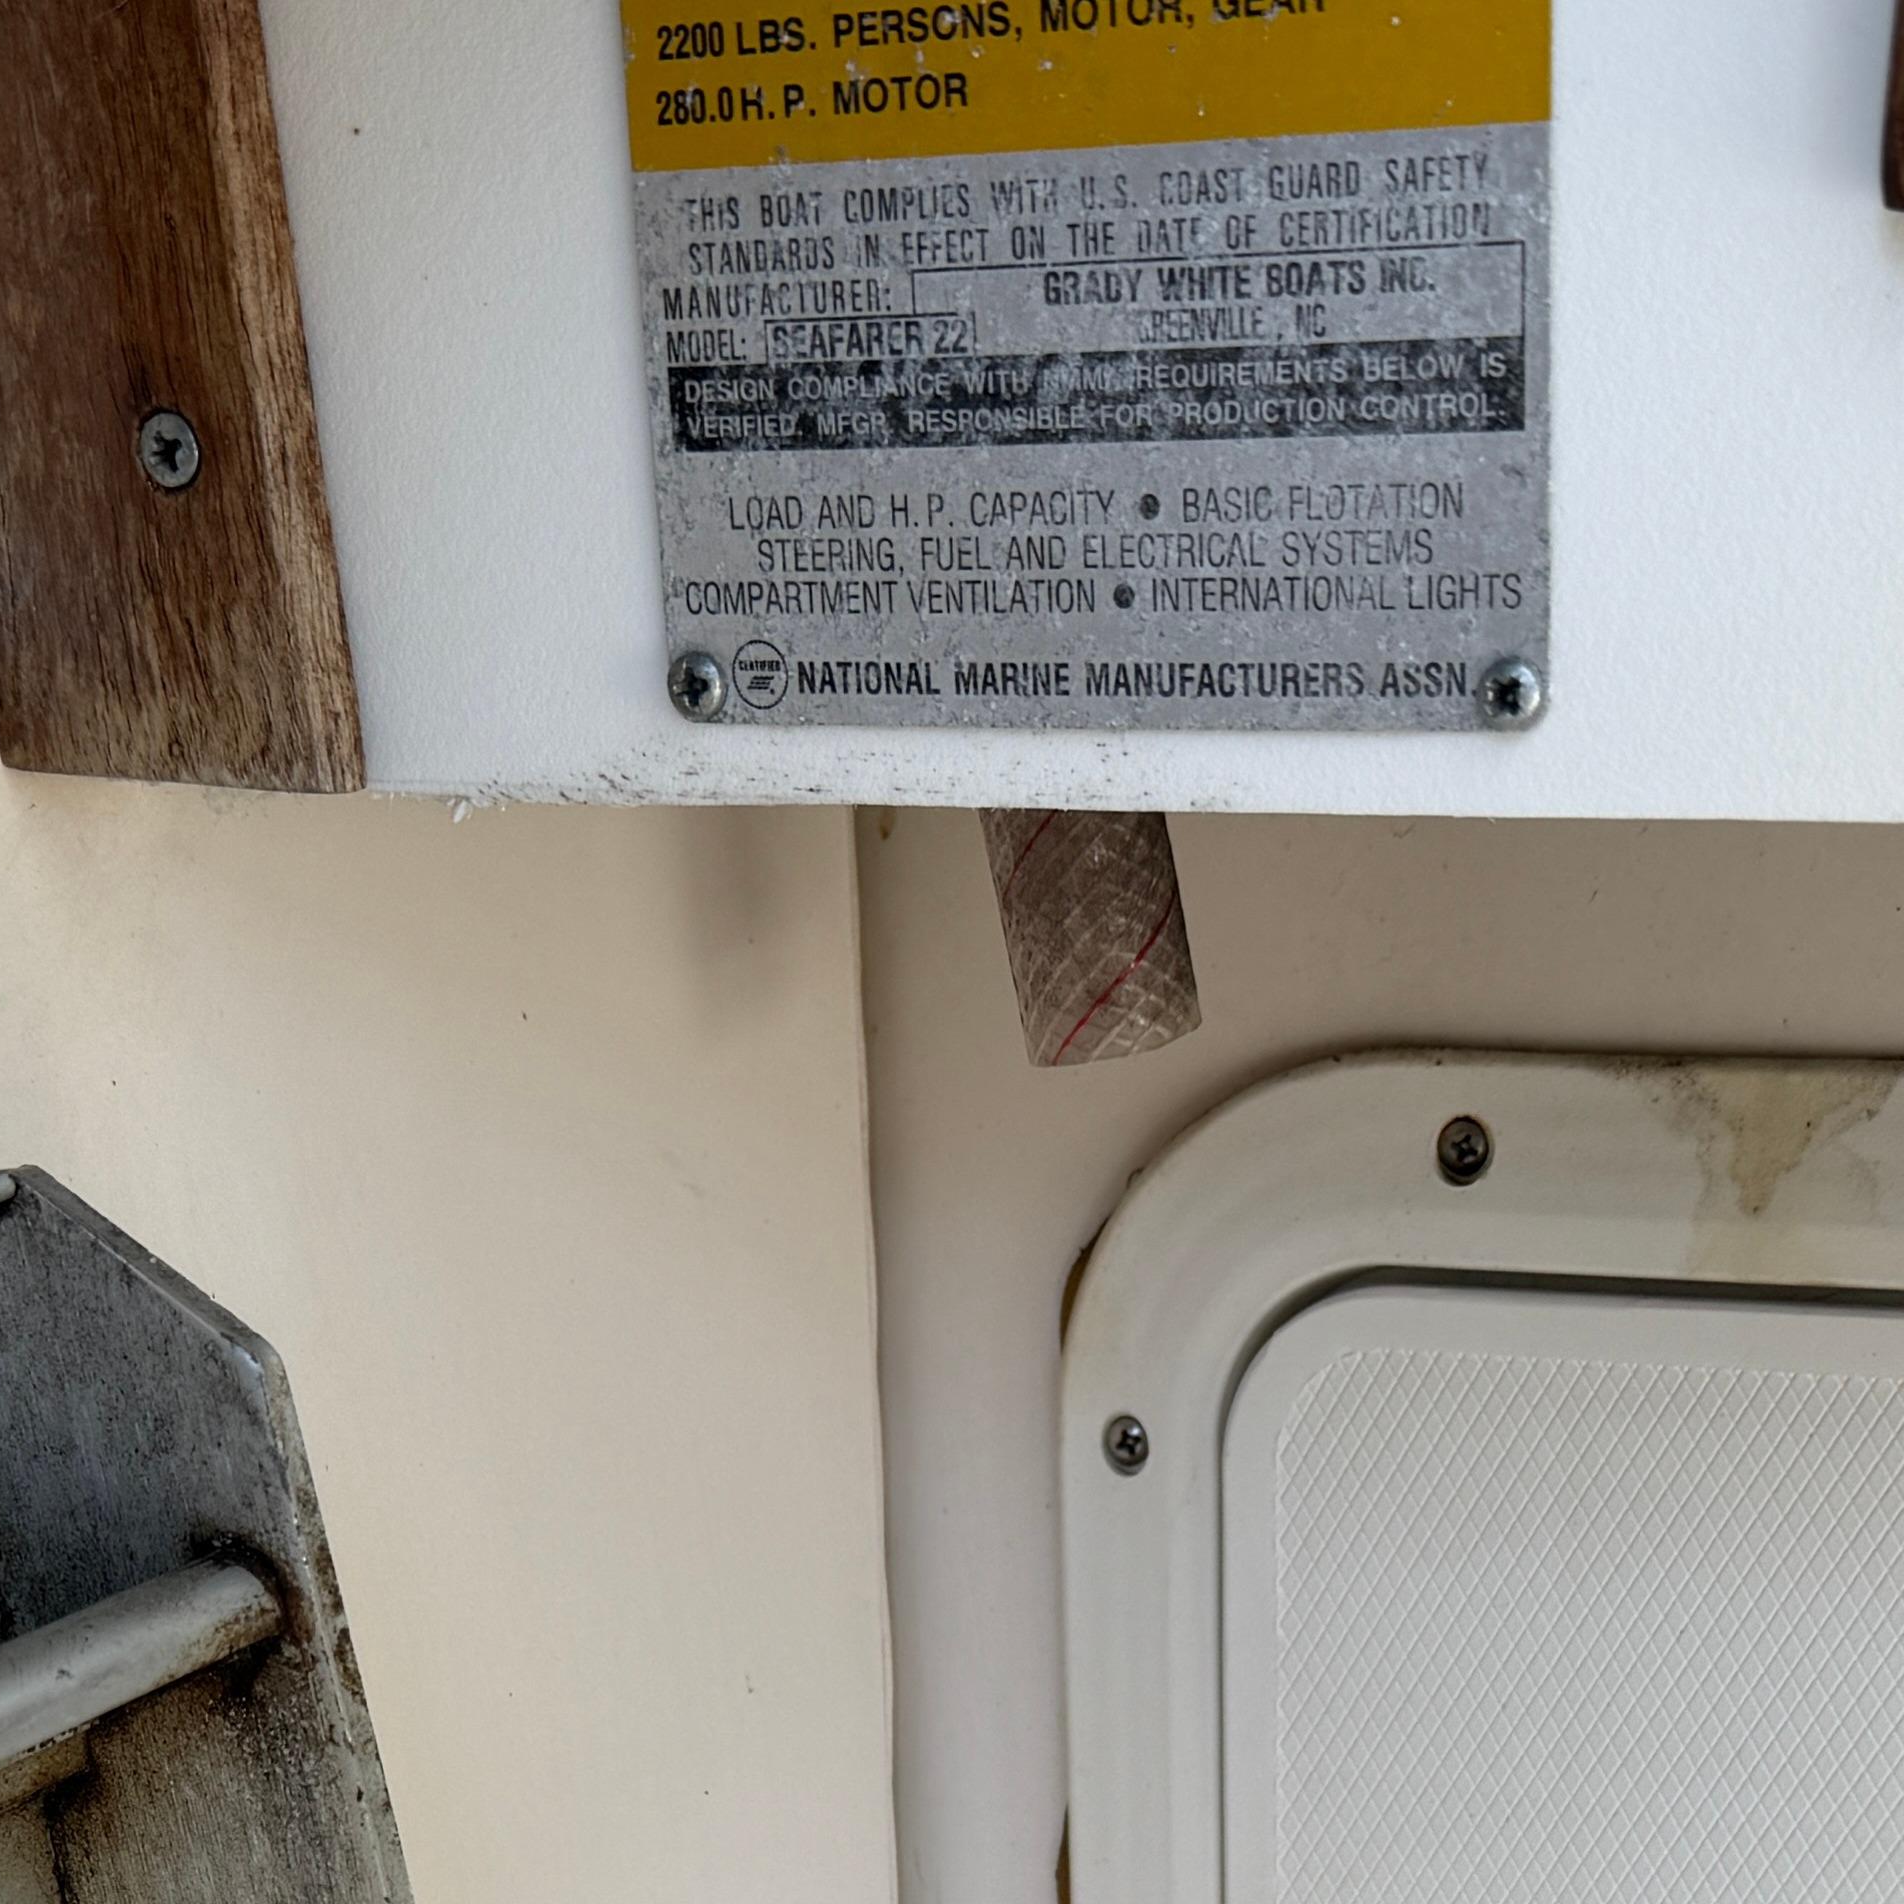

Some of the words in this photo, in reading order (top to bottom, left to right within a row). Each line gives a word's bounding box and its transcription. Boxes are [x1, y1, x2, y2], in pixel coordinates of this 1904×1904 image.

[657, 21, 724, 61] 2200
[736, 17, 816, 56] LBS.
[833, 1, 1022, 48] PERSONS,
[1041, 0, 1194, 32] MOTOR,
[832, 72, 968, 115] MOTOR
[684, 196, 740, 232] THIS
[759, 191, 823, 228] BOAT
[844, 183, 971, 224] COMPLIES
[990, 177, 1058, 215] WITH
[1159, 167, 1245, 208] COAST
[1268, 160, 1361, 201] GUARD
[1385, 153, 1489, 194] SAFETY
[688, 236, 835, 276] STANDARDS
[856, 233, 881, 268] IN
[902, 228, 989, 266] EFFECT
[1011, 224, 1046, 260] ON
[1066, 221, 1116, 257] THE
[1137, 216, 1202, 252] DATE
[1225, 214, 1257, 250] OF
[1279, 202, 1490, 248] CERTIFICATION
[662, 278, 892, 321] MANUFACTURER:
[1045, 267, 1143, 306] GRADY
[1157, 264, 1252, 301] WHITE
[1266, 259, 1366, 298] BOATS
[1379, 255, 1436, 294] INC.
[666, 329, 747, 364] MODEL:
[772, 320, 924, 359] SEAFARER
[933, 319, 969, 354] 22
[1295, 303, 1327, 339] NC
[684, 378, 775, 403] DESIGN
[788, 372, 951, 400] COMPLIANCE
[963, 370, 1030, 395] WITH
[1137, 358, 1347, 389] REQUIREMENTS
[1362, 353, 1464, 383] BELOW
[1480, 351, 1507, 378] IS
[686, 411, 803, 439] VERIFIED.
[908, 405, 1086, 433] RESPONSIBLE
[1100, 403, 1153, 428] FOR
[1170, 397, 1346, 425] PRODUCTION
[1360, 392, 1506, 421] CONTROL.
[729, 496, 804, 531] LOAD
[817, 495, 875, 529] AND
[970, 489, 1114, 528] CAPACITY
[1182, 485, 1273, 524] BASIC
[1288, 482, 1465, 522] FLOTATION
[758, 537, 904, 576] STEERING,
[921, 536, 991, 572] FUEL
[1006, 535, 1066, 570] AND
[1084, 531, 1266, 570] ELECTRICAL
[1282, 528, 1433, 567] SYSTEMS
[684, 579, 897, 615] COMPARTMENT
[907, 578, 1096, 614] VENTILATION
[1151, 575, 1396, 612] INTERNATIONAL
[1407, 573, 1522, 610] LIGHTS
[797, 660, 941, 695] NATIONAL
[954, 660, 1071, 696] MARINE
[1086, 660, 1365, 698] MANUFACTURERS
[1380, 661, 1477, 699] ASSN.
